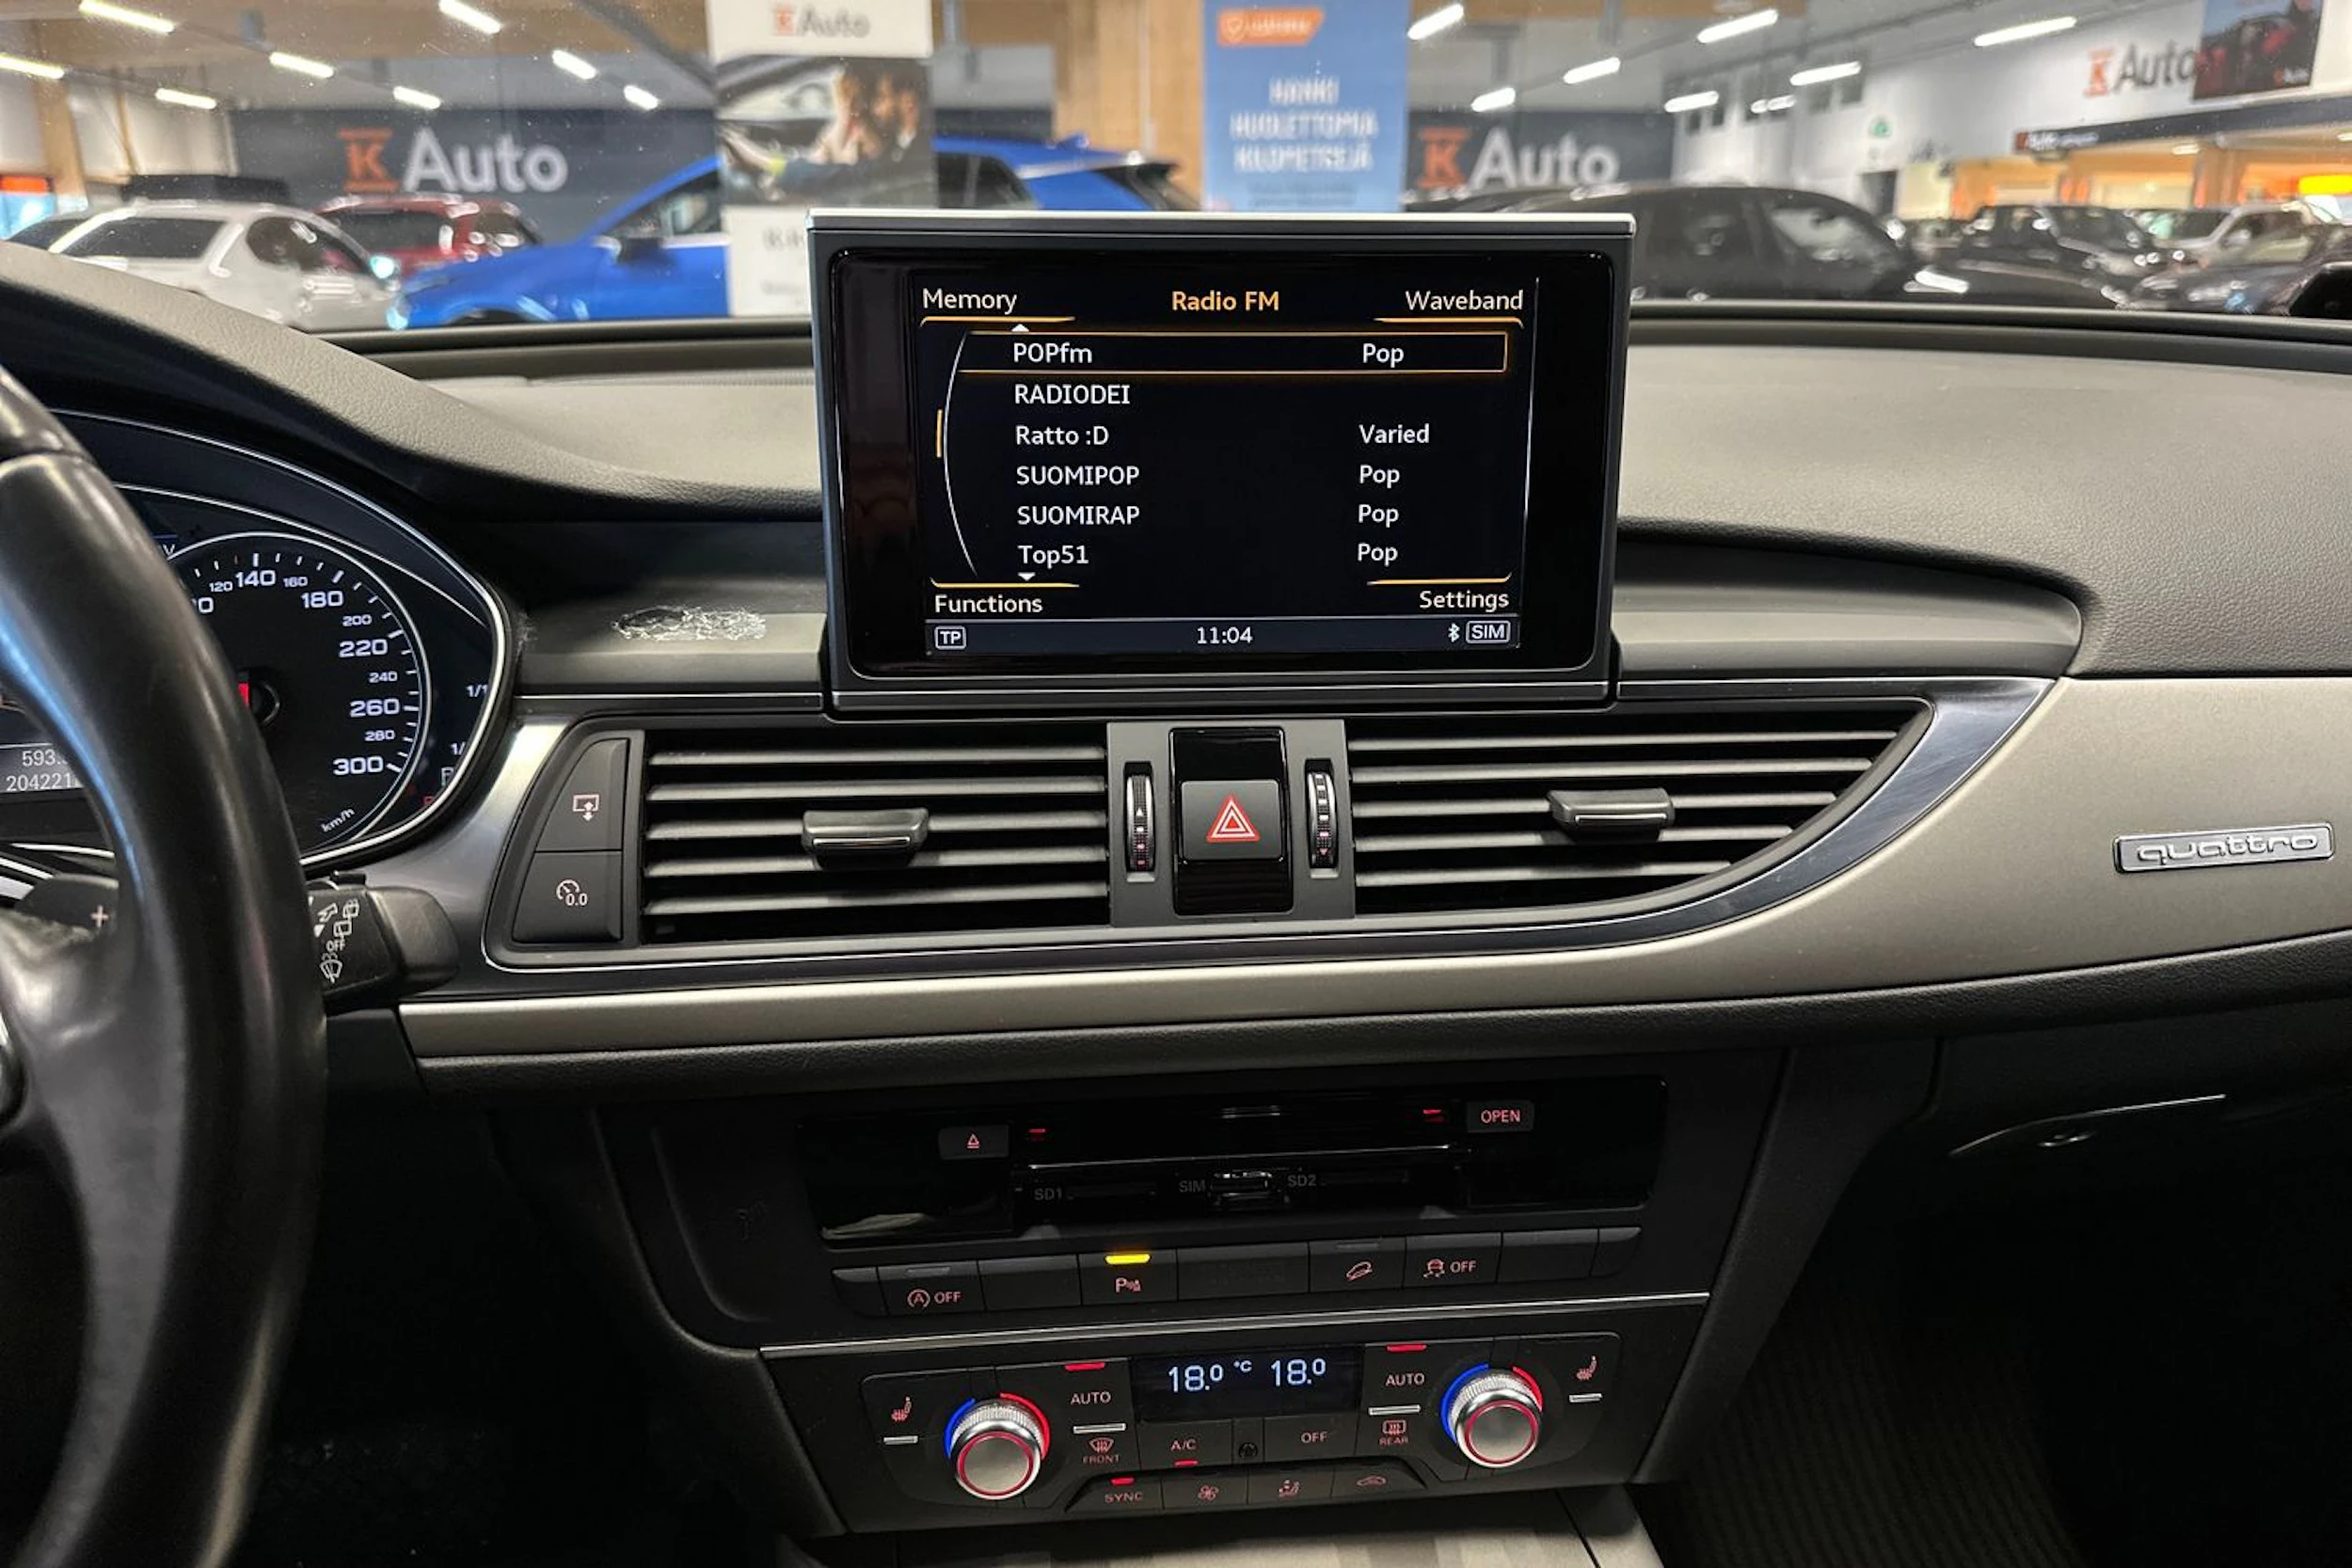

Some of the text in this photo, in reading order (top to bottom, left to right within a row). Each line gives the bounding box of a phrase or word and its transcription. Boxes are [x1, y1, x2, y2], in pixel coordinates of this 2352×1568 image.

[403, 129, 567, 193] Auto
[1470, 129, 1619, 189] Auto
[922, 288, 1018, 315] Memory
[1171, 289, 1279, 311] Radio FM
[1405, 289, 1524, 310] Waveband
[1013, 341, 1092, 364] POPfm
[1362, 342, 1405, 369] Pop
[1014, 383, 1131, 404] RADIODEI
[1015, 424, 1109, 446] Ratto :D
[1359, 422, 1430, 444] Varied
[1016, 465, 1140, 486] SUOMIPOP
[1359, 464, 1400, 489] Pop
[1017, 505, 1140, 526] SUOMIRAP
[1358, 503, 1400, 529] Pop
[1017, 545, 1089, 570] Top51
[1358, 542, 1398, 567] Pop
[209, 580, 233, 593] 120
[235, 569, 277, 588] 140
[282, 576, 309, 588] 160
[194, 595, 215, 614] 0
[301, 590, 344, 609] 180
[934, 594, 1043, 613] Functions
[1419, 590, 1510, 612] Settings
[342, 613, 373, 627] 200
[939, 630, 961, 645] TP
[1197, 626, 1253, 644] 11:04
[1470, 624, 1506, 640] SIM
[339, 638, 389, 658] 220
[369, 671, 398, 684] 240
[350, 698, 401, 718] 260
[364, 729, 396, 742] 280
[22, 749, 68, 767] 593.
[333, 755, 384, 776] 300
[4, 770, 72, 793] 204221
[321, 808, 355, 832] km/h
[2137, 833, 2319, 865] quattro
[326, 940, 346, 952] OFF
[1480, 1109, 1521, 1124] OPEN
[1178, 1178, 1207, 1195] SIM
[1287, 1174, 1317, 1188] SD2
[1034, 1186, 1062, 1201] SD1
[1449, 1259, 1476, 1274] OFF
[933, 1291, 961, 1305] OFF
[1385, 1372, 1425, 1386] AUTO
[1070, 1391, 1111, 1405] AUTO
[1170, 1438, 1196, 1451] A/C
[1300, 1431, 1327, 1444] OFF
[1378, 1433, 1409, 1446] REAR
[1082, 1453, 1120, 1465] FRONT
[1104, 1492, 1142, 1503] SYNC
